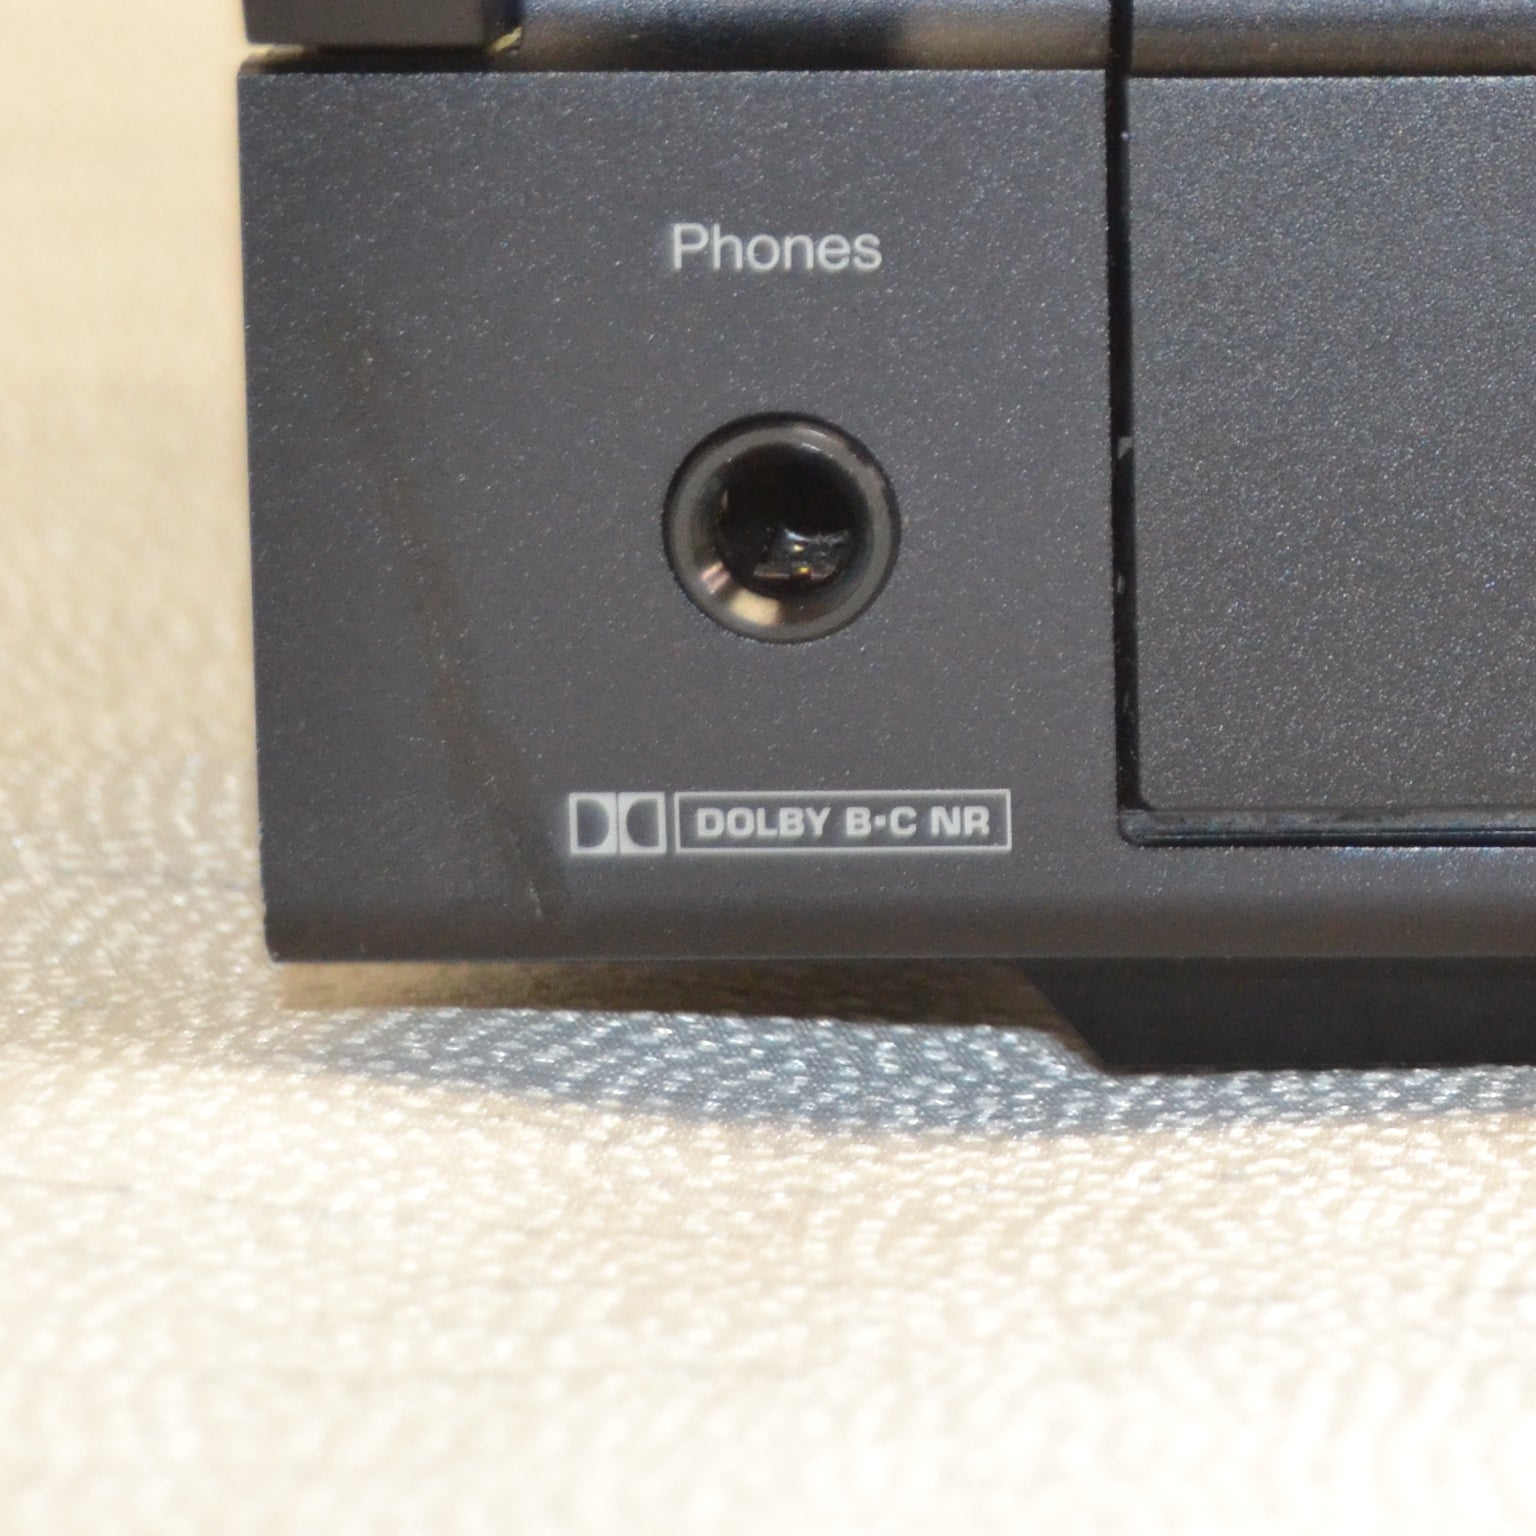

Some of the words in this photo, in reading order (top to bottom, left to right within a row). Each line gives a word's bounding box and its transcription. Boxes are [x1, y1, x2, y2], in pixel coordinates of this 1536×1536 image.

[671, 223, 883, 271] Phones
[696, 807, 831, 838] DOLBY
[929, 804, 991, 837] NR
